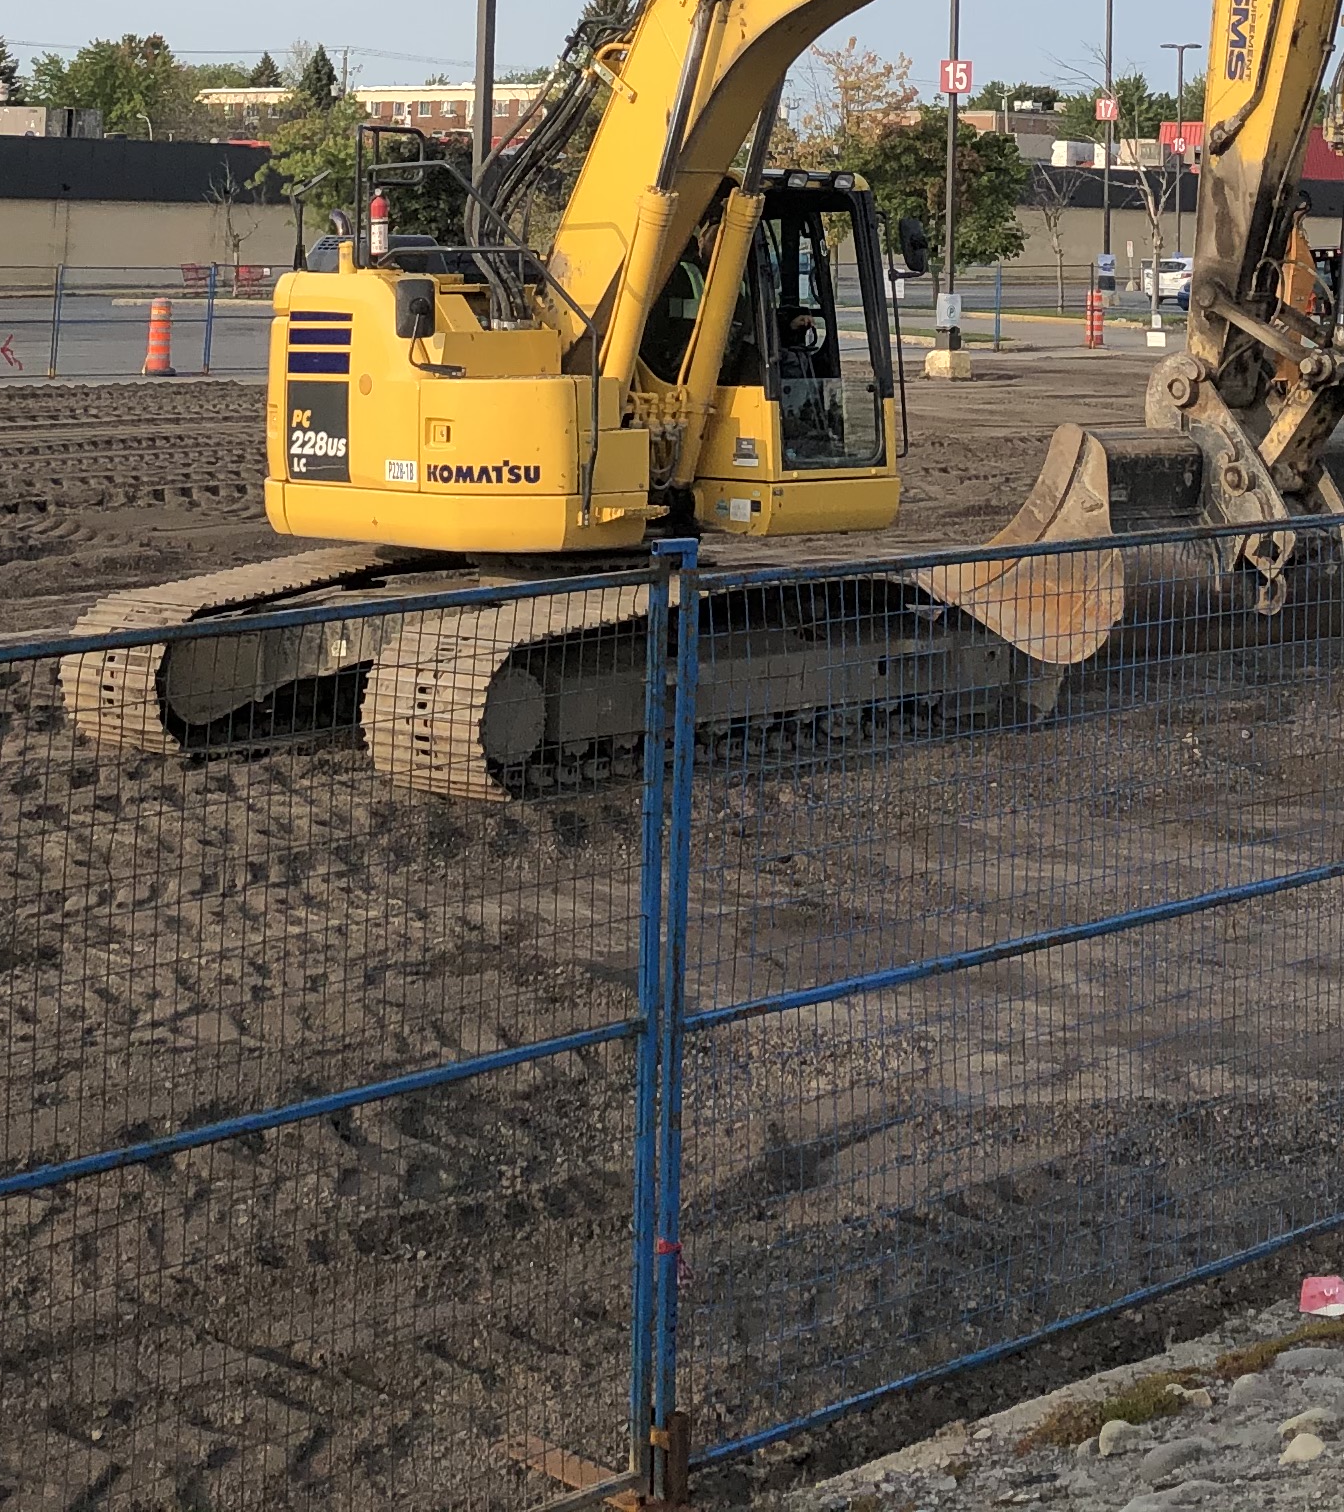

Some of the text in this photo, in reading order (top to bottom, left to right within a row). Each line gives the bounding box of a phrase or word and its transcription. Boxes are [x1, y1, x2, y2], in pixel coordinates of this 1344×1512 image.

[945, 62, 967, 90] 15
[1099, 99, 1115, 118] 17
[291, 409, 311, 428] PC
[293, 457, 307, 473] LC
[388, 461, 414, 482] P228-1B
[426, 459, 541, 484] KOMATSU
